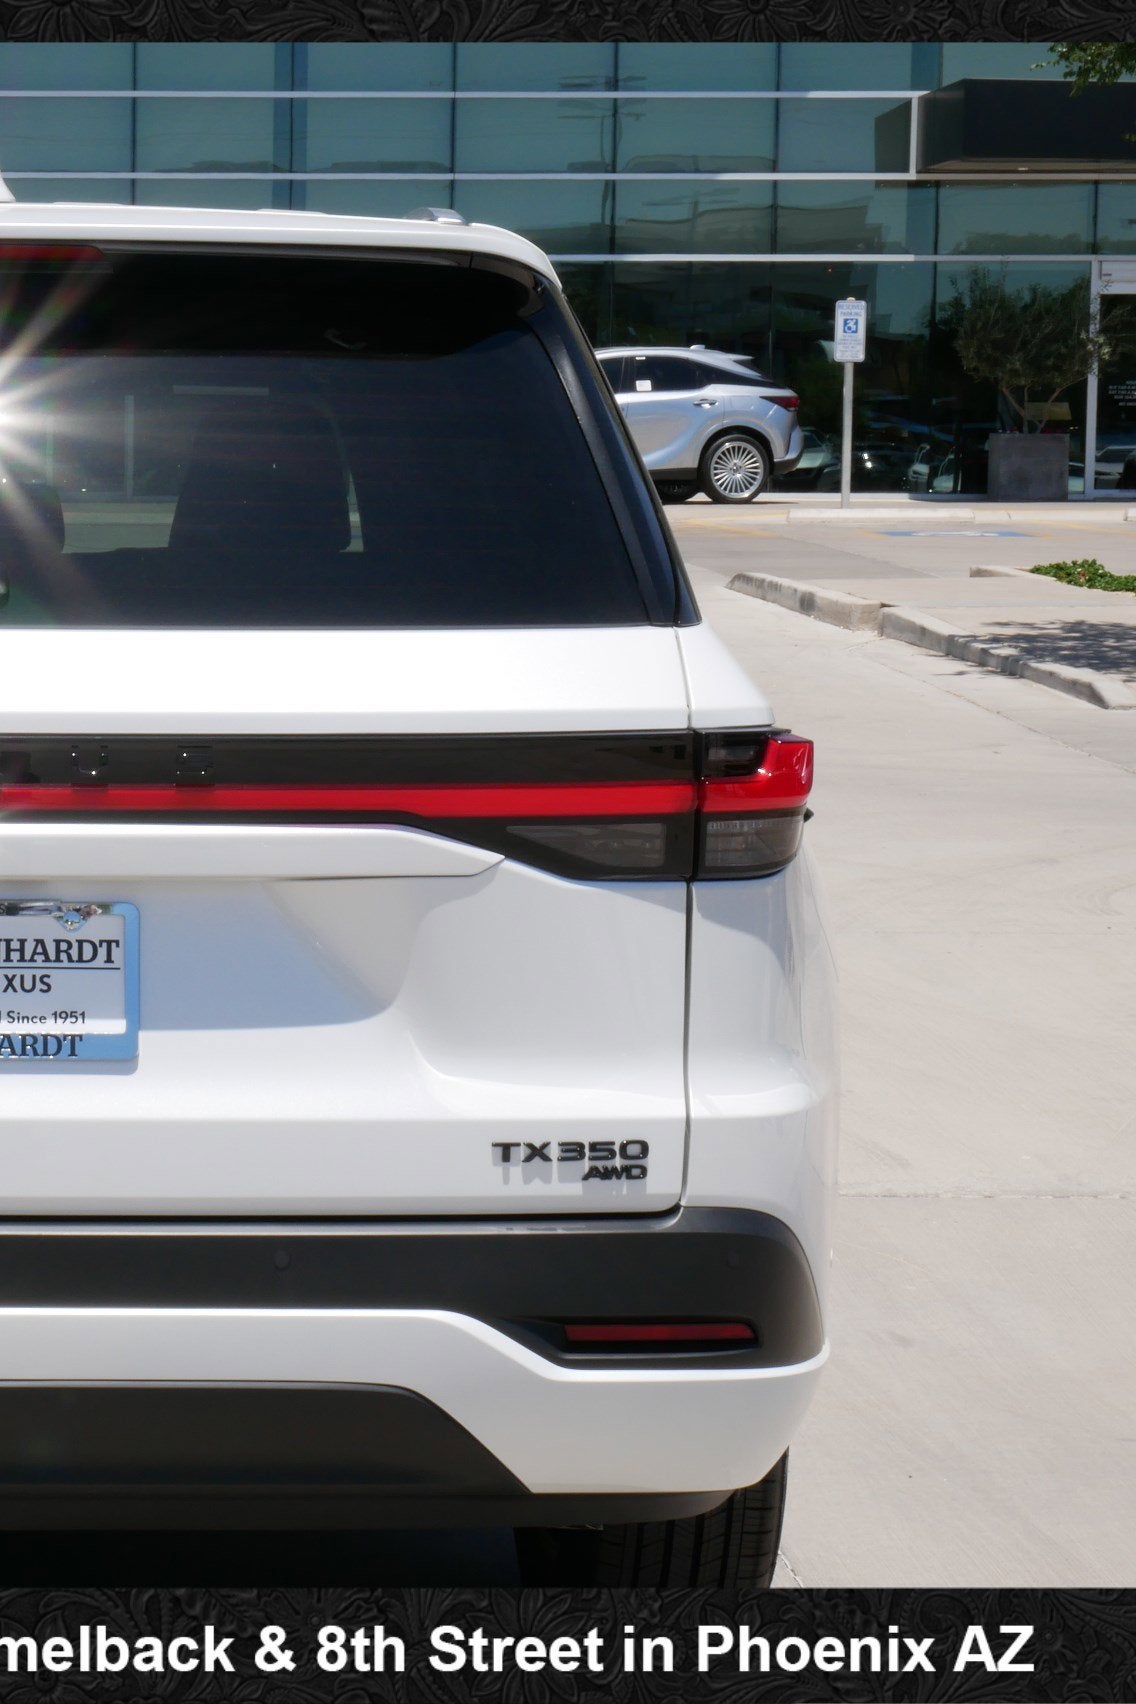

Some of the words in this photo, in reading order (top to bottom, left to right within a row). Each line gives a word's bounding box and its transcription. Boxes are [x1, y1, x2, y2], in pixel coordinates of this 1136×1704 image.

[6, 1010, 47, 1024] Since
[51, 1010, 86, 1024] 1951
[582, 1164, 648, 1181] AWD
